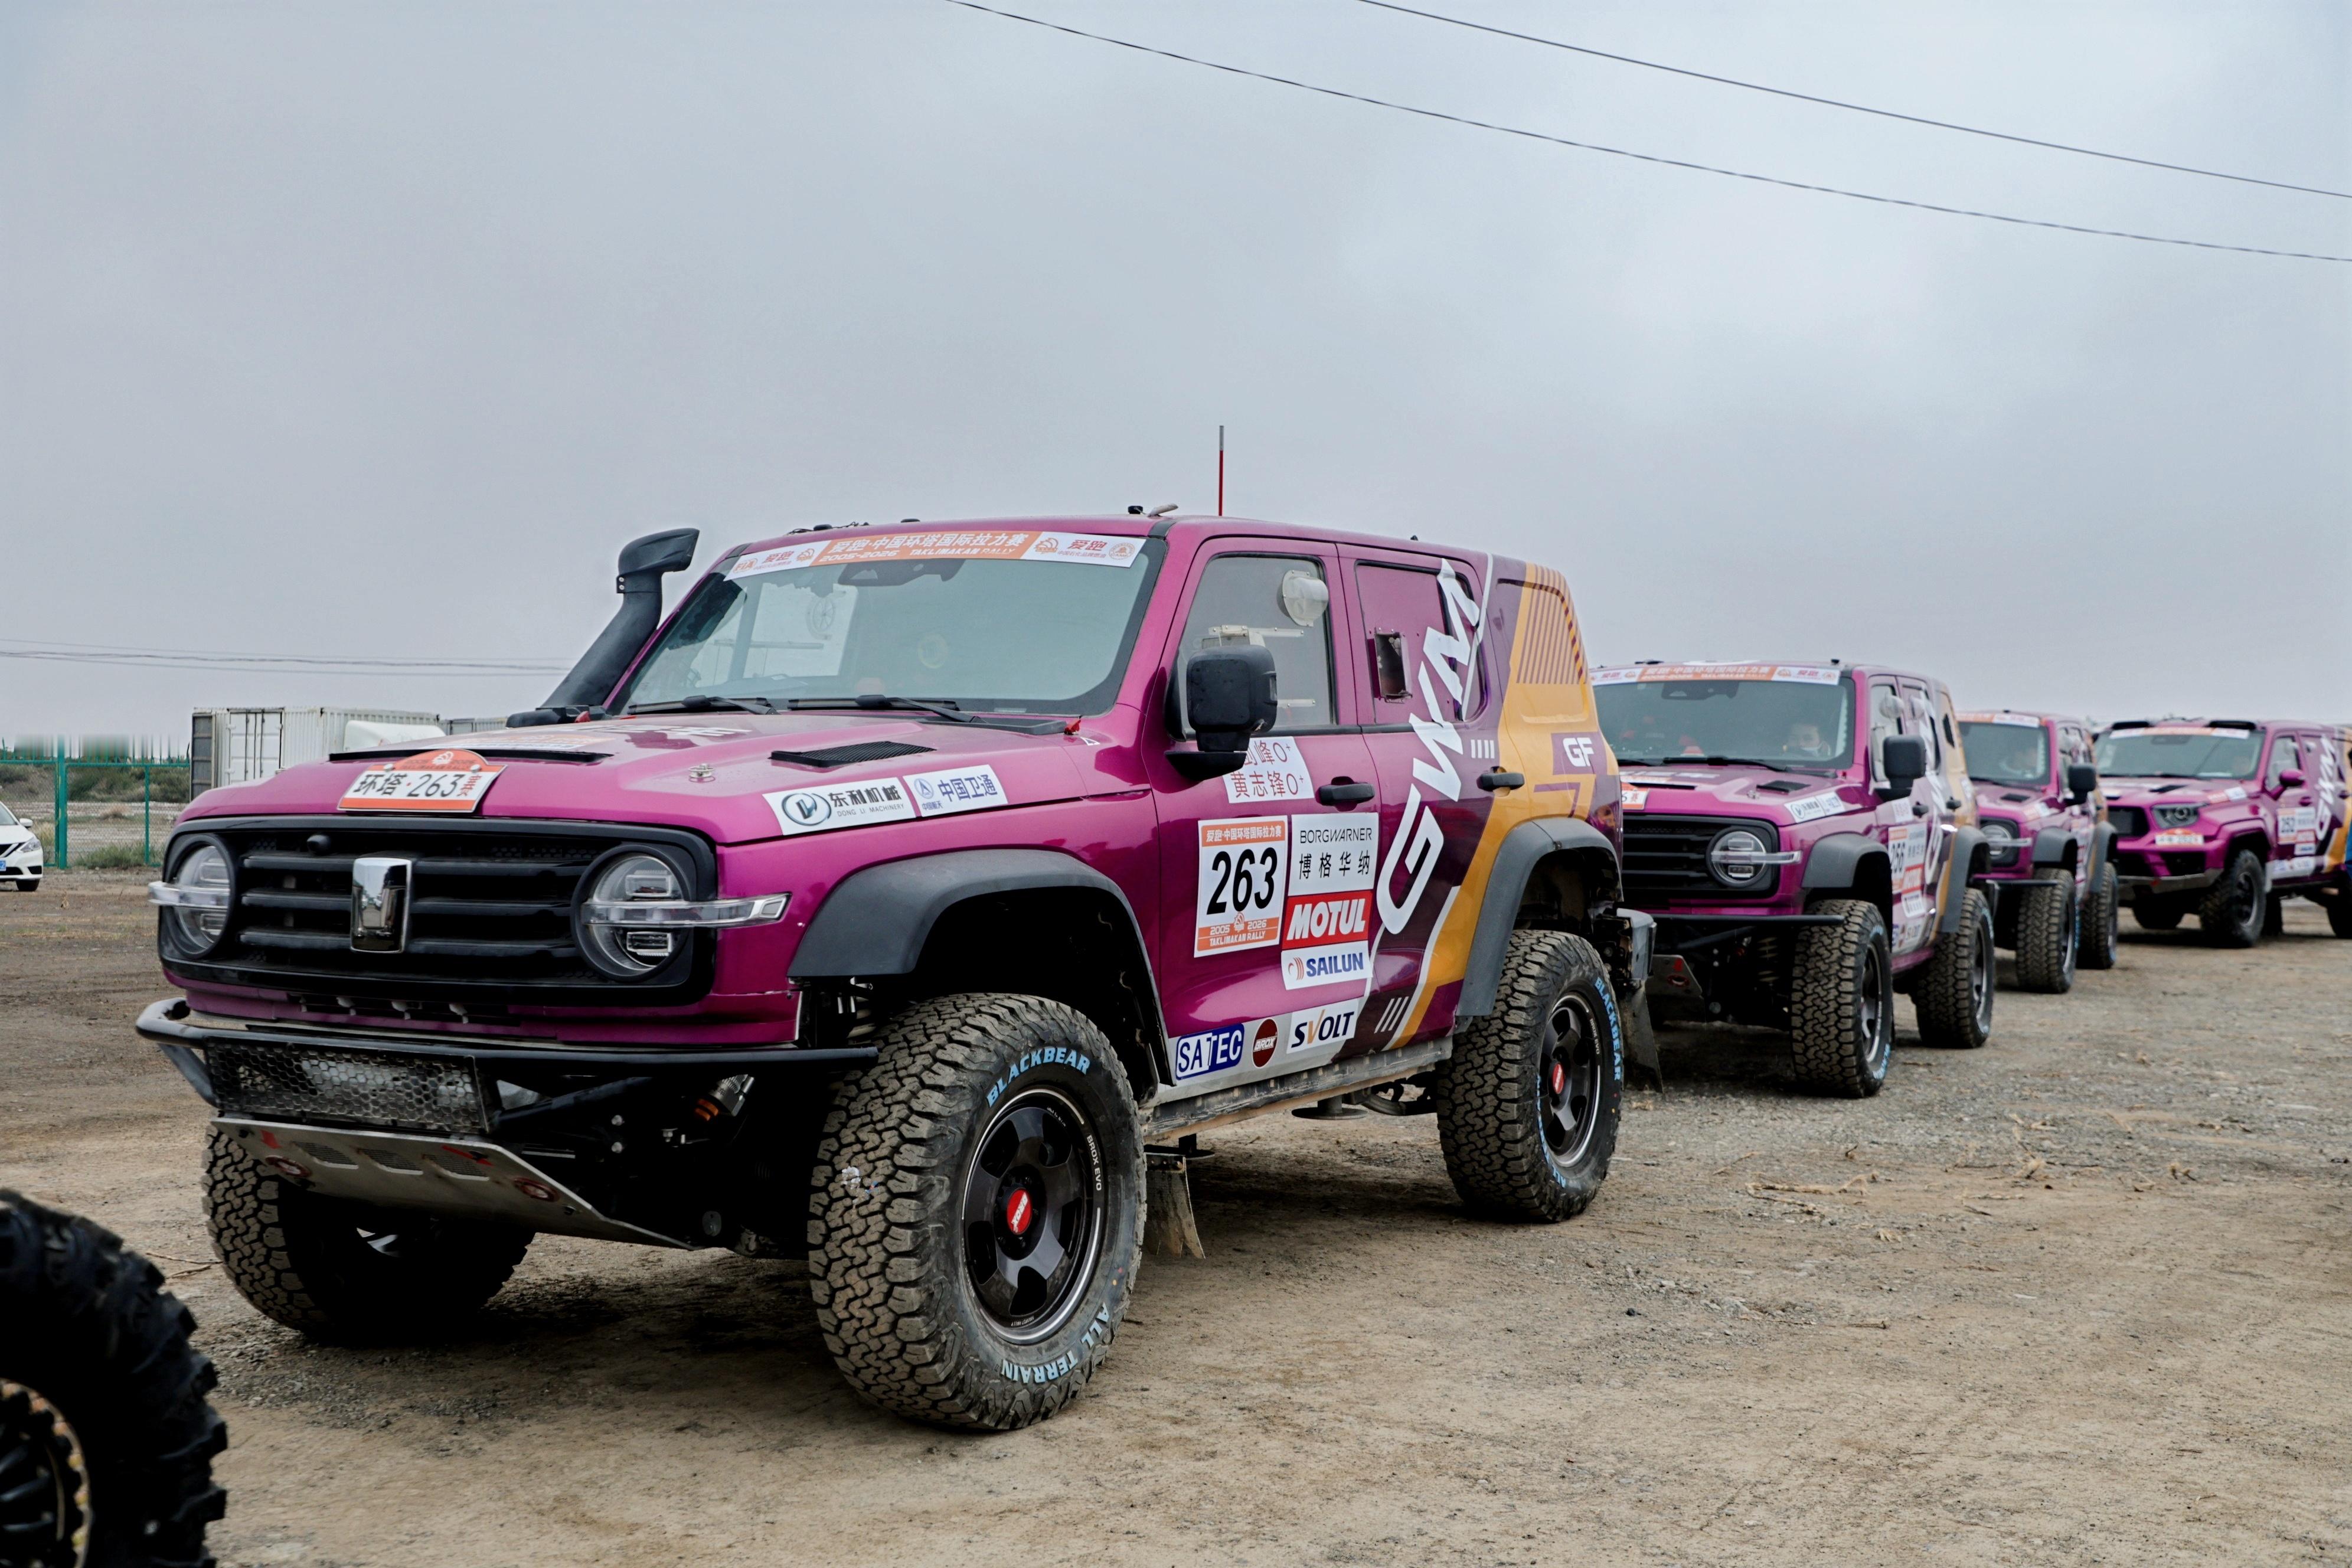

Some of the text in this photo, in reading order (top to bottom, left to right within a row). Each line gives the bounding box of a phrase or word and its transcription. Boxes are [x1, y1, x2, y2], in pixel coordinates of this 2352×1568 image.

[819, 550, 900, 562] 2005-2026
[910, 548, 981, 556] TAKLIMAKAN
[1067, 540, 1108, 551] 爱跑
[1376, 558, 1481, 935] GWM
[1563, 737, 1595, 767] GF
[828, 785, 903, 808] 东利机械
[937, 774, 998, 802] 中国卫通
[837, 808, 857, 818] DONG
[869, 803, 905, 813] MACHINERY
[1206, 825, 1282, 843] 爱跑·中国环塔国际拉力赛
[1300, 828, 1373, 844] BORGWARNER
[1299, 850, 1370, 880] 博格华纳
[1206, 847, 1278, 916] 263
[1210, 919, 1267, 935] 2005 2026
[1286, 898, 1366, 941] MOTUL
[1210, 930, 1266, 947] TAKLIMAKAN RALLY
[1306, 952, 1364, 978] SAILUN
[1291, 1008, 1355, 1048] SVOLT
[1595, 976, 1621, 1081] BLACKBEAR
[1177, 1029, 1243, 1073] SATEC
[986, 1046, 1090, 1108] BLACKBEAR
[1086, 1134, 1099, 1165] BROX
[1001, 1301, 1110, 1384] ALL TERRAIN
